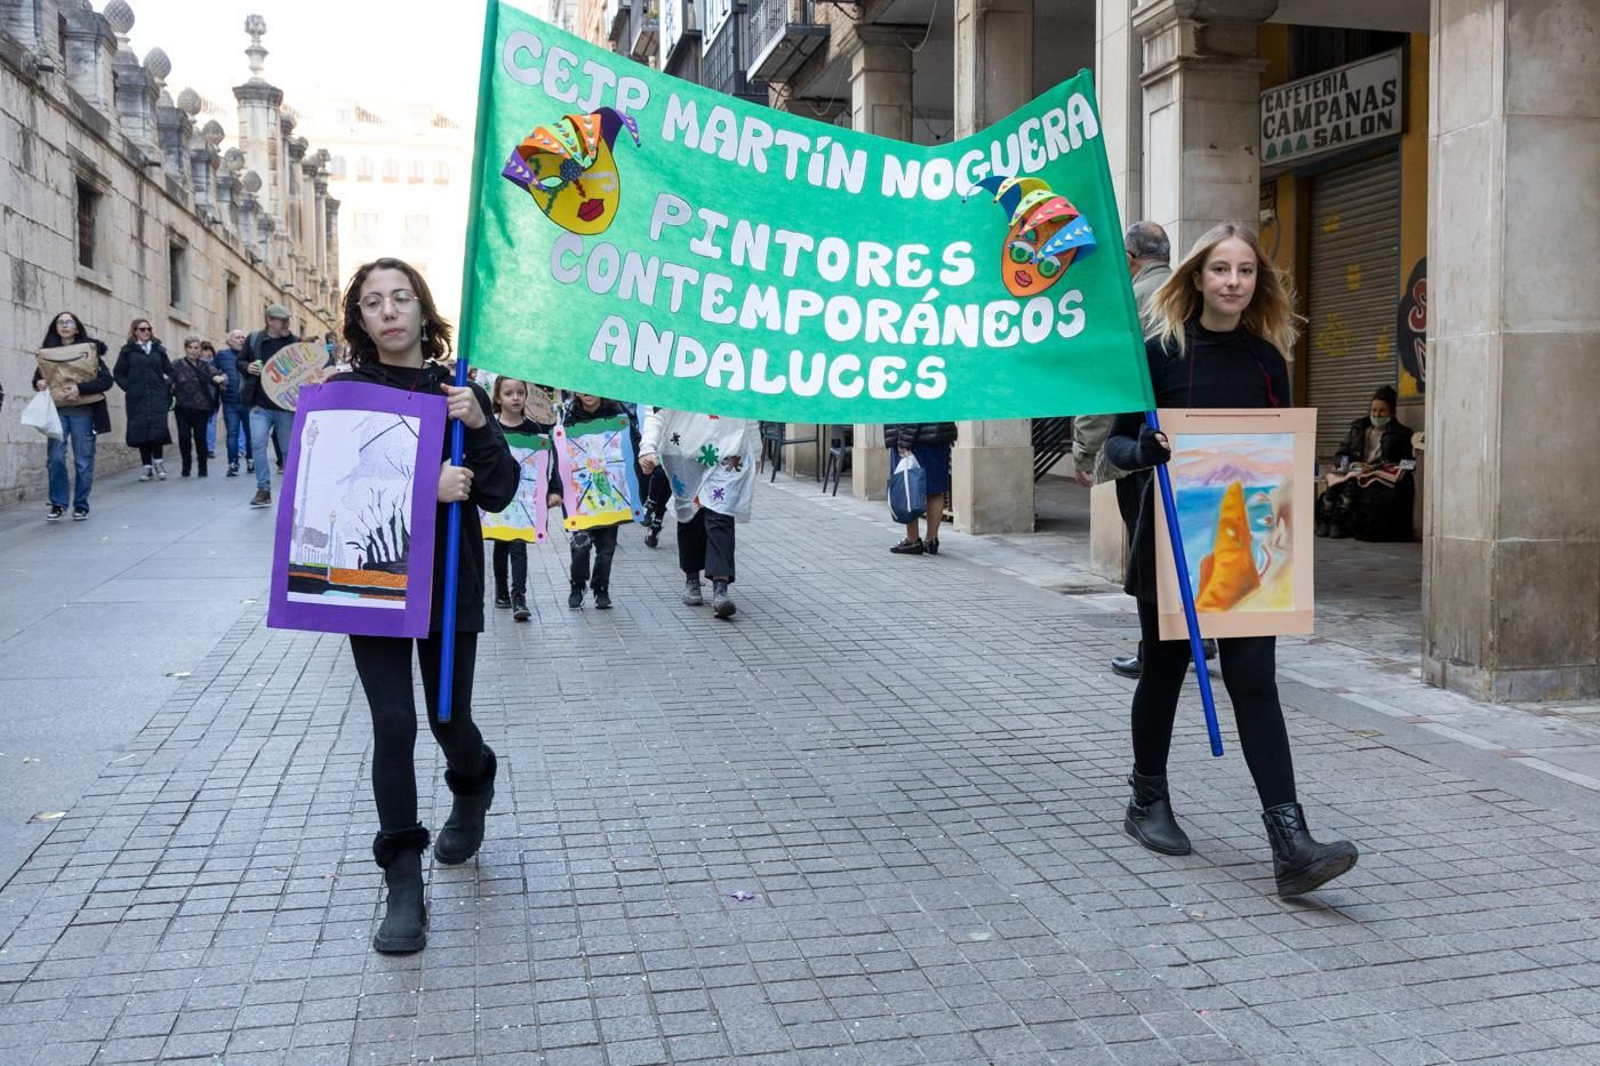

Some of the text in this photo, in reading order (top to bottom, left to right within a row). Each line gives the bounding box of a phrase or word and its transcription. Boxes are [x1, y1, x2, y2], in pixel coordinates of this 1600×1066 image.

[503, 30, 1099, 201] CEIP MARTÍN NOGUERA
[1263, 78, 1397, 140] CAMPANAS
[1265, 71, 1349, 113] CAFETERIA
[1313, 109, 1393, 148] SALON
[650, 194, 975, 288] PINTORES
[550, 233, 1086, 348] CONTEMPORÁNEOS
[589, 316, 948, 399] ANDALUCES
